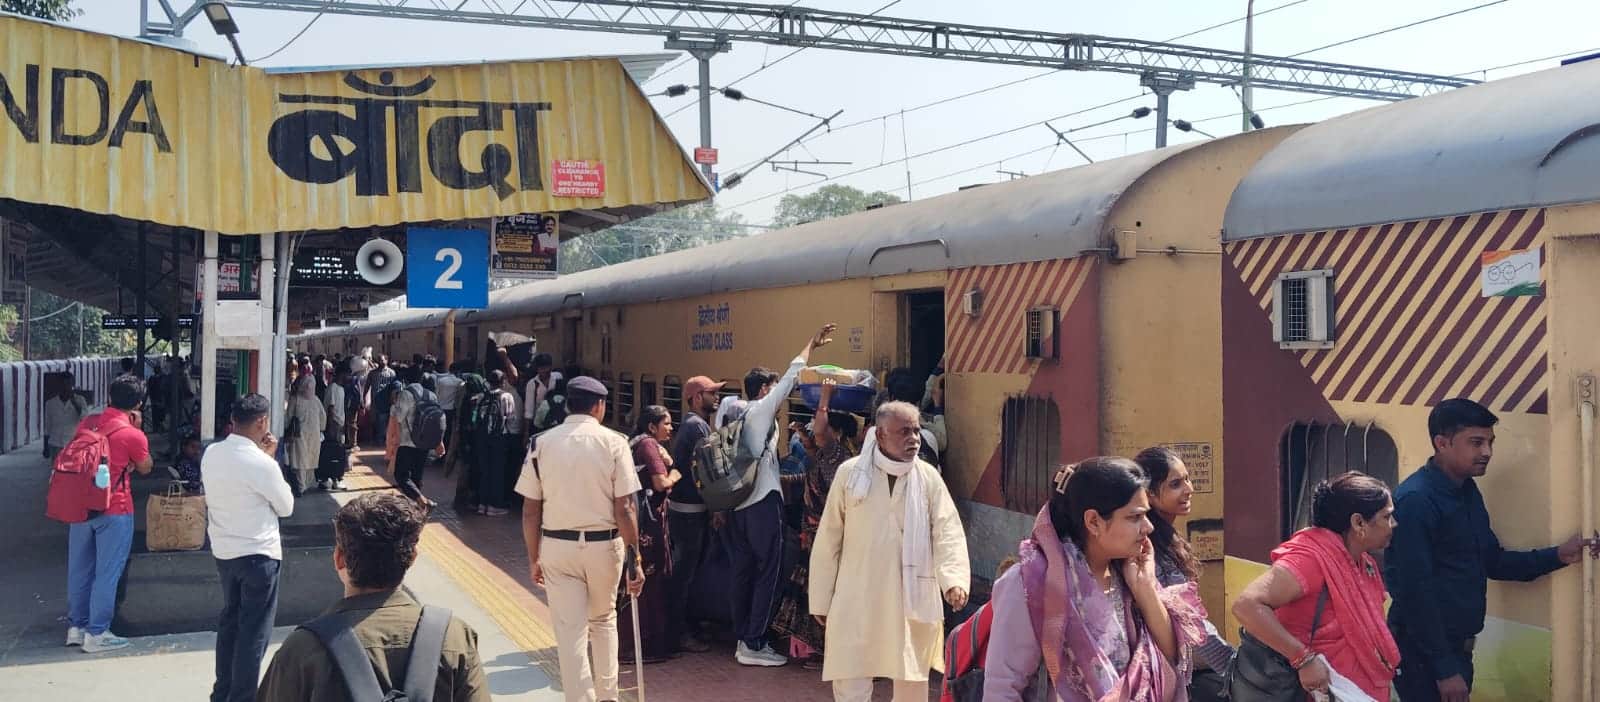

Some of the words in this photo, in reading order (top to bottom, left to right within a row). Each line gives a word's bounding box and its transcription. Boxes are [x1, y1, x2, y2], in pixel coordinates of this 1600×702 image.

[558, 187, 599, 195] RESTRICTED
[434, 247, 463, 290] 2
[692, 333, 713, 351] SECOND
[715, 332, 733, 350] CLASS
